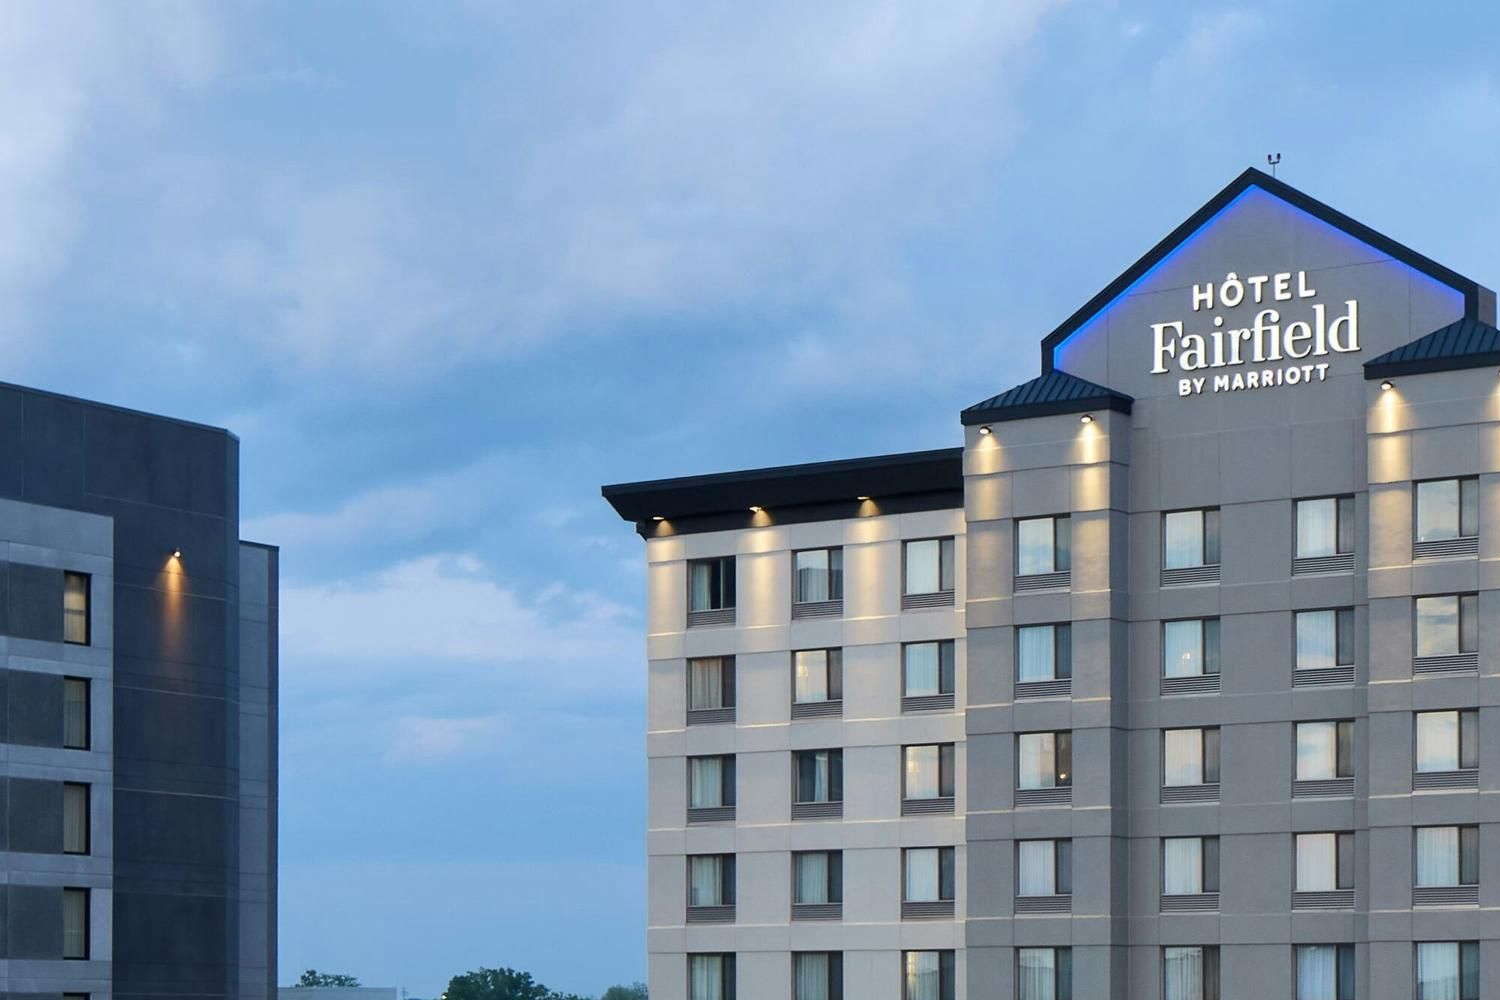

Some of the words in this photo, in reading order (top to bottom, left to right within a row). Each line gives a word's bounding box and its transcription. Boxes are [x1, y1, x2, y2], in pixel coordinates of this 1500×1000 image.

[1192, 271, 1316, 311] HÔTEL
[1150, 300, 1362, 374] Fairfield
[1178, 376, 1206, 396] BY
[1213, 363, 1330, 393] MARRIOTT
